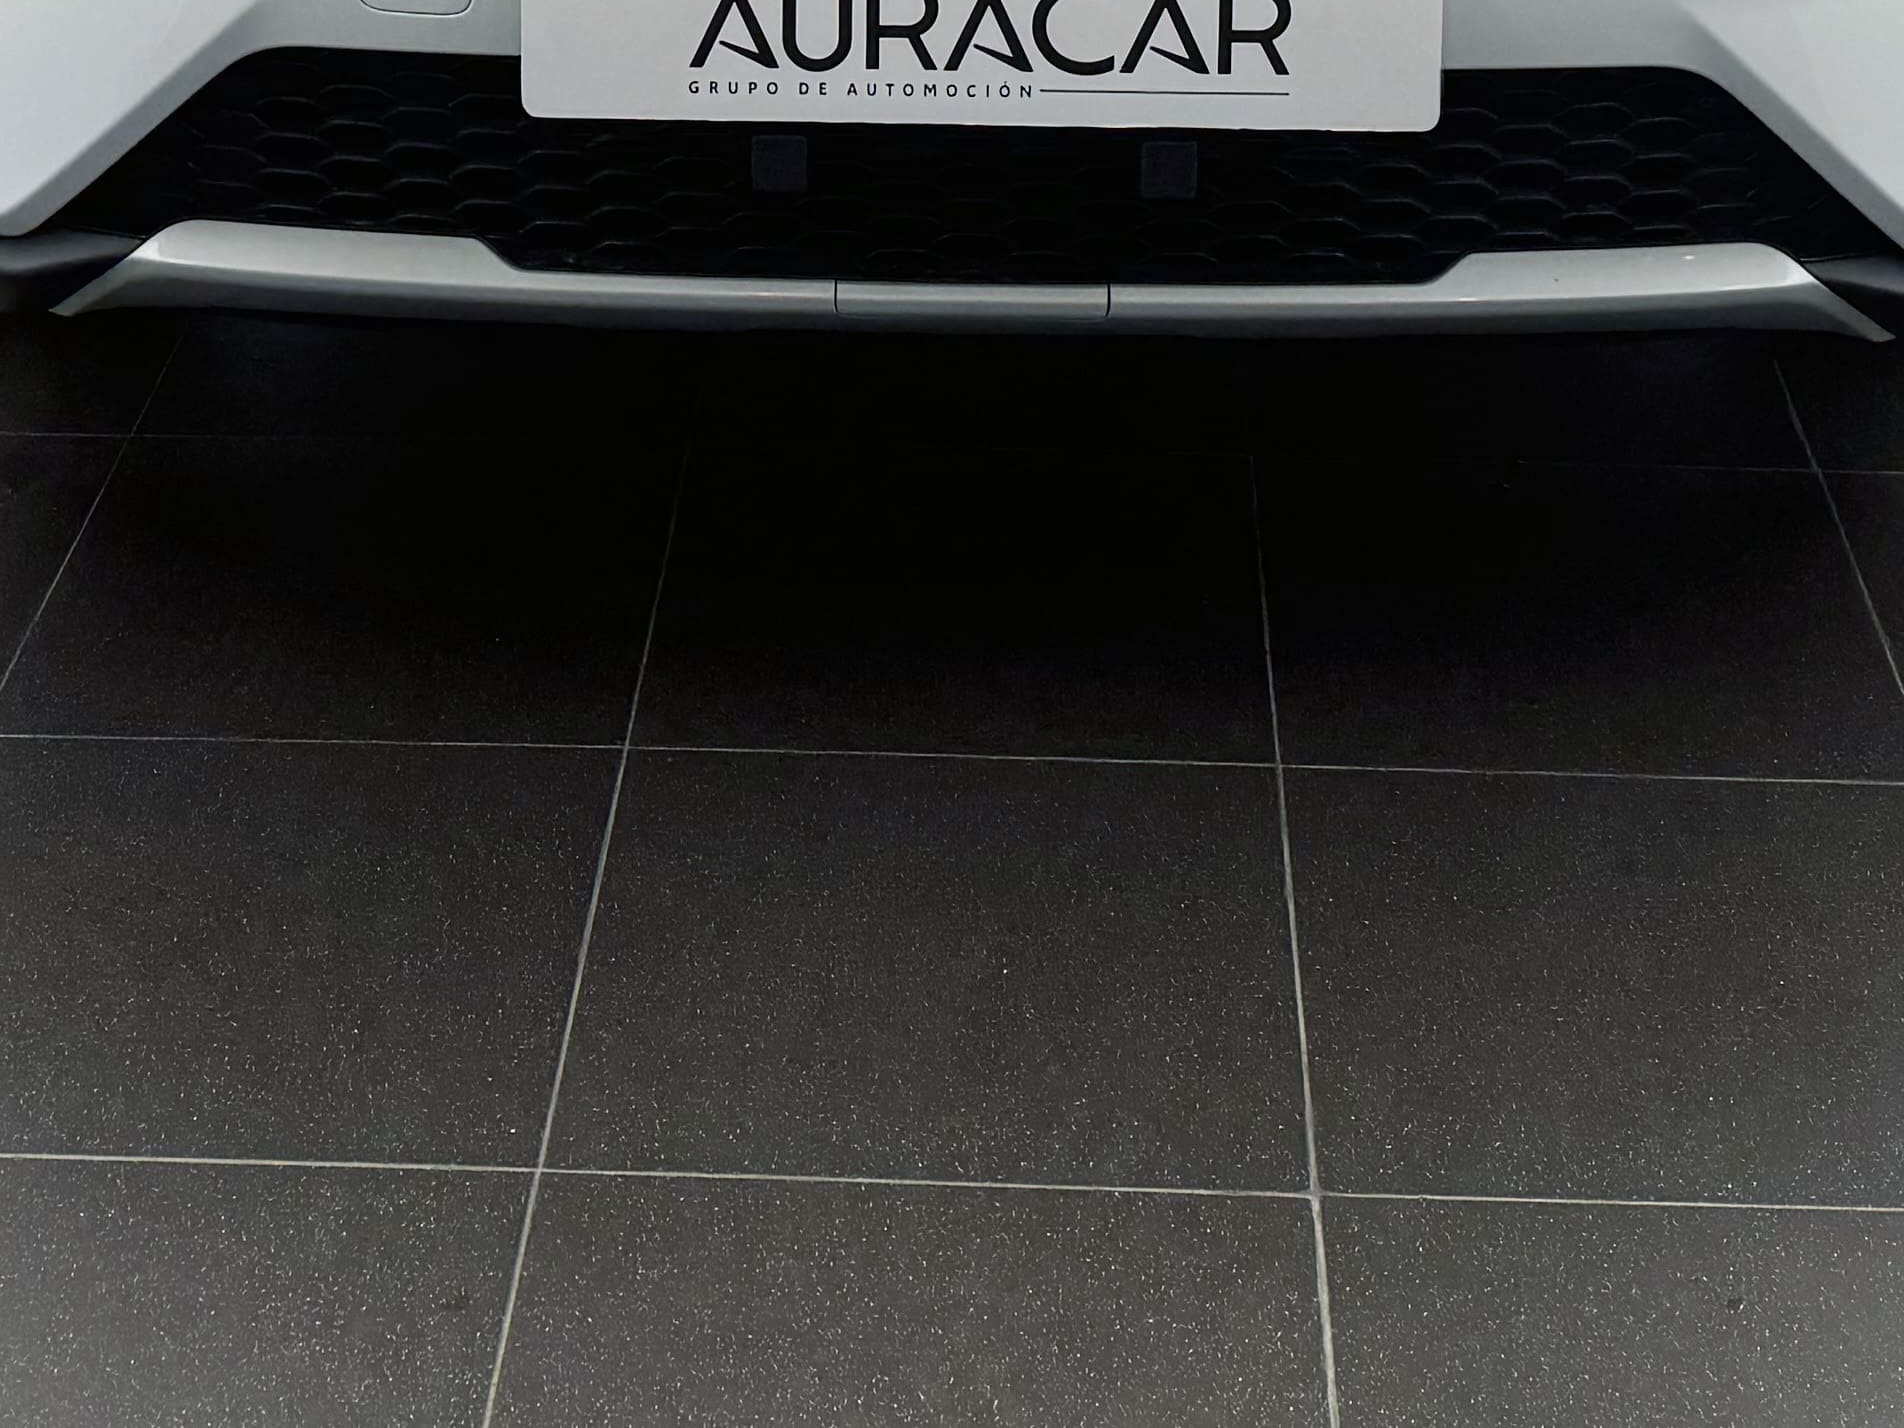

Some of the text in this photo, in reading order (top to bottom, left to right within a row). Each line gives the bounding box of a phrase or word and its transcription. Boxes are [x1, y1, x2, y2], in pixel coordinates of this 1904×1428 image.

[688, 80, 1032, 99] GRUPO DE AUTOMOCIÓN
